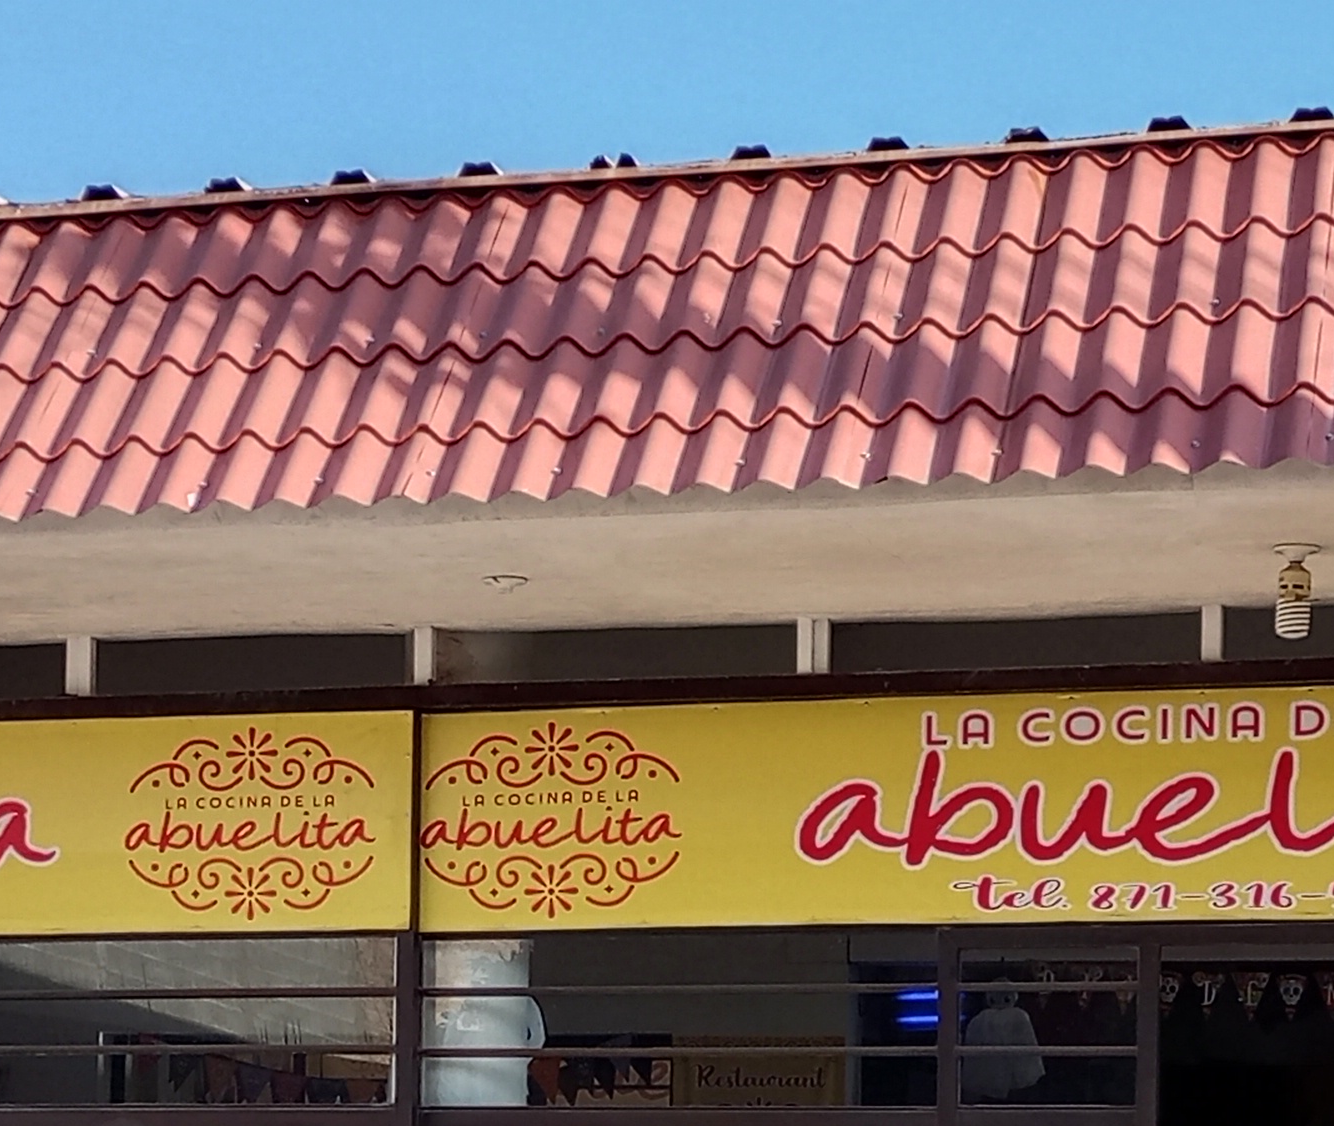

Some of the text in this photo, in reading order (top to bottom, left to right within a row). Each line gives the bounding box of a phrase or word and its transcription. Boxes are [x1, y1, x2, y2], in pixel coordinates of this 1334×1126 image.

[924, 714, 990, 746] LA
[1020, 706, 1261, 742] COCINA
[165, 794, 336, 811] LA COCINA DE LA
[462, 789, 640, 808] LA COCINA DE LA
[123, 810, 377, 854] abuelita
[419, 805, 683, 852] abuelita
[953, 875, 1069, 912] tel.
[696, 1064, 826, 1088] Restaurant
